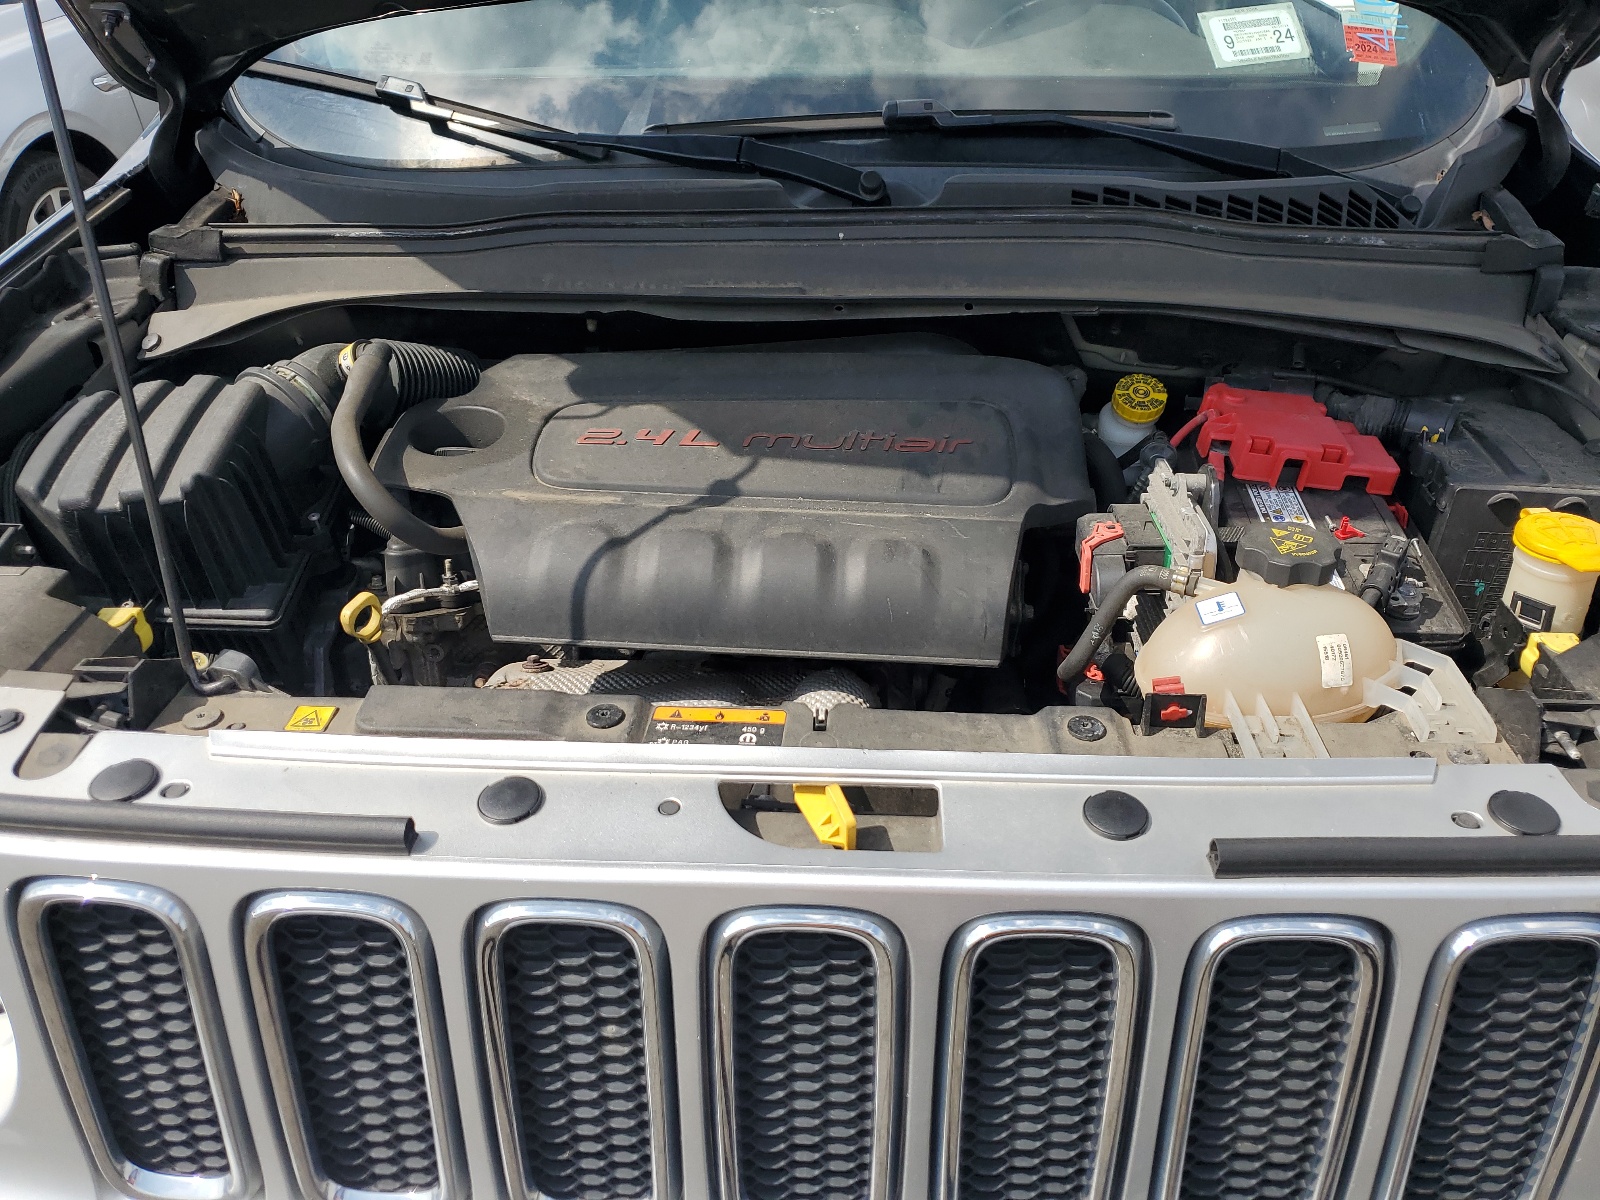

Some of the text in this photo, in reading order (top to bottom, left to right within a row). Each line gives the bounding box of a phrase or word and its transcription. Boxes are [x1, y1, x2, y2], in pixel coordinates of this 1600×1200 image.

[1223, 35, 1235, 50] 9
[1273, 28, 1295, 44] 24
[1355, 43, 1378, 53] 2024
[576, 427, 974, 455] 2.4L multiair
[670, 723, 708, 732] R-1234yf
